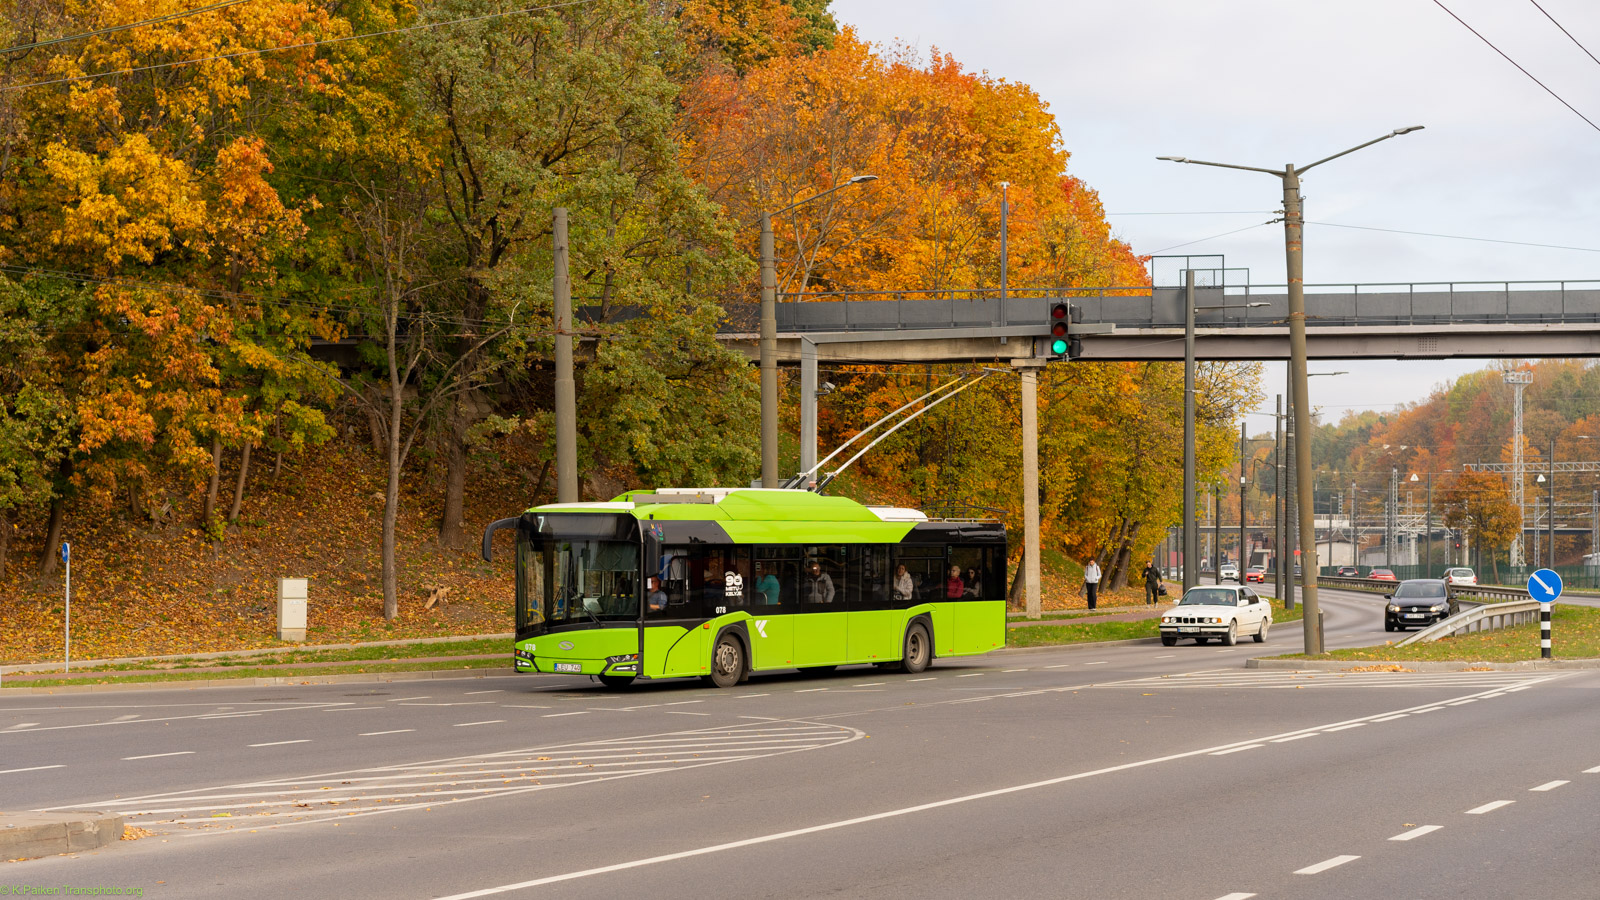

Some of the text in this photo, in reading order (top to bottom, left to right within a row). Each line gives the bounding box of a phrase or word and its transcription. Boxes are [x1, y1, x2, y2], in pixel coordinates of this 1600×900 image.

[538, 516, 545, 533] 7
[715, 606, 727, 614] 078
[525, 643, 536, 651] 078
